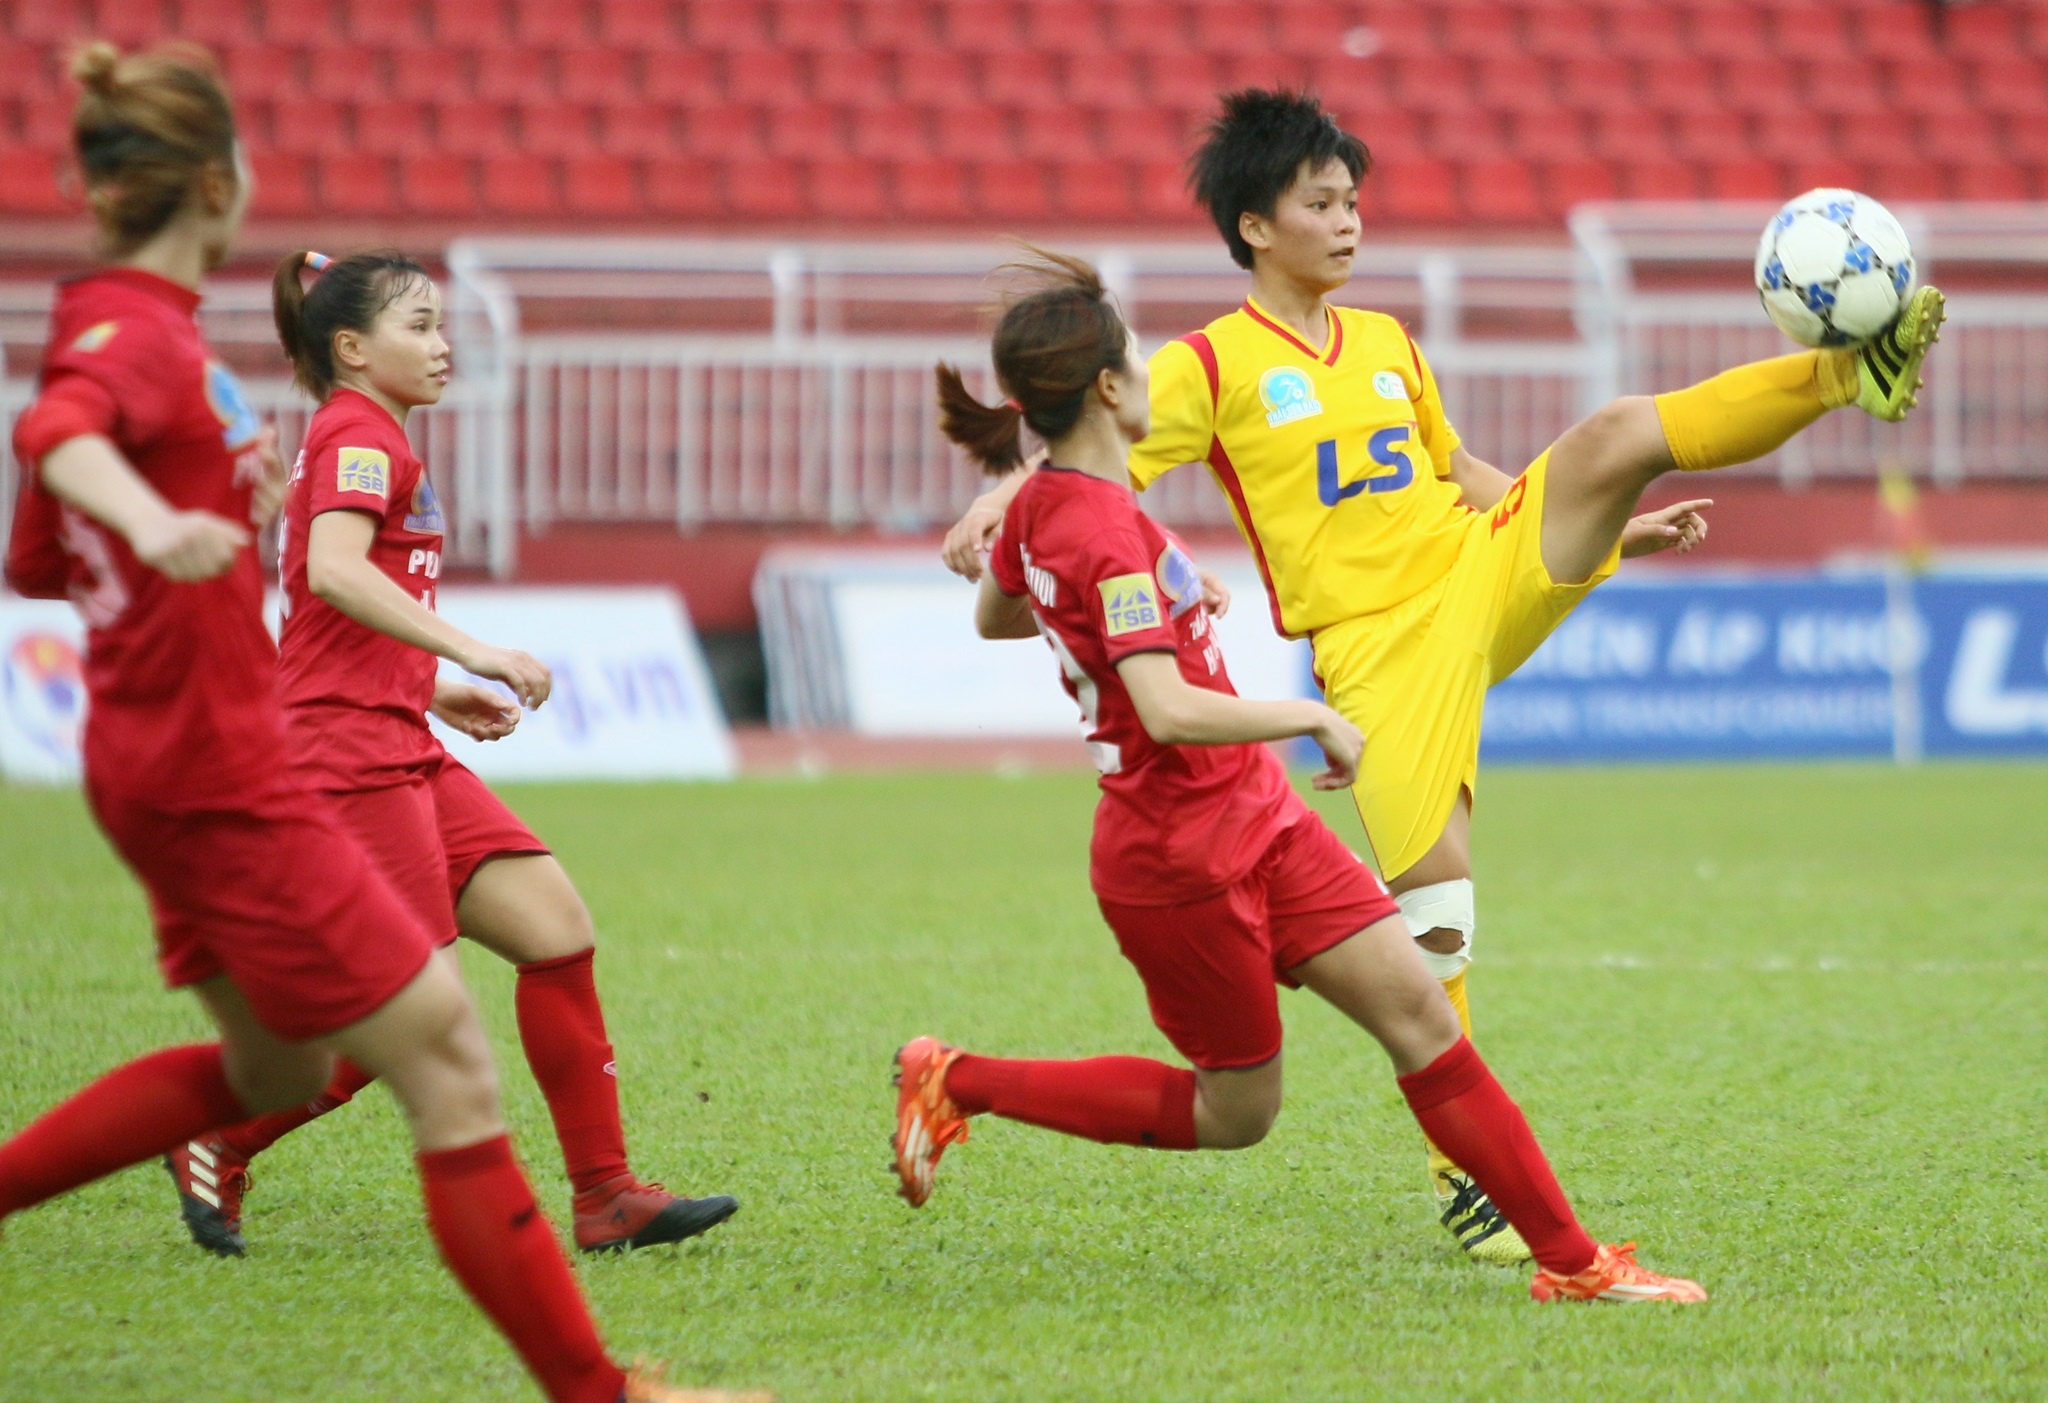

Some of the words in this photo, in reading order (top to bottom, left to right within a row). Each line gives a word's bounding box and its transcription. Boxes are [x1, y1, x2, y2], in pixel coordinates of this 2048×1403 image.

[341, 473, 385, 492] TSB
[1316, 426, 1414, 507] LS
[1108, 606, 1156, 629] TSB
[1944, 608, 2048, 733] L
